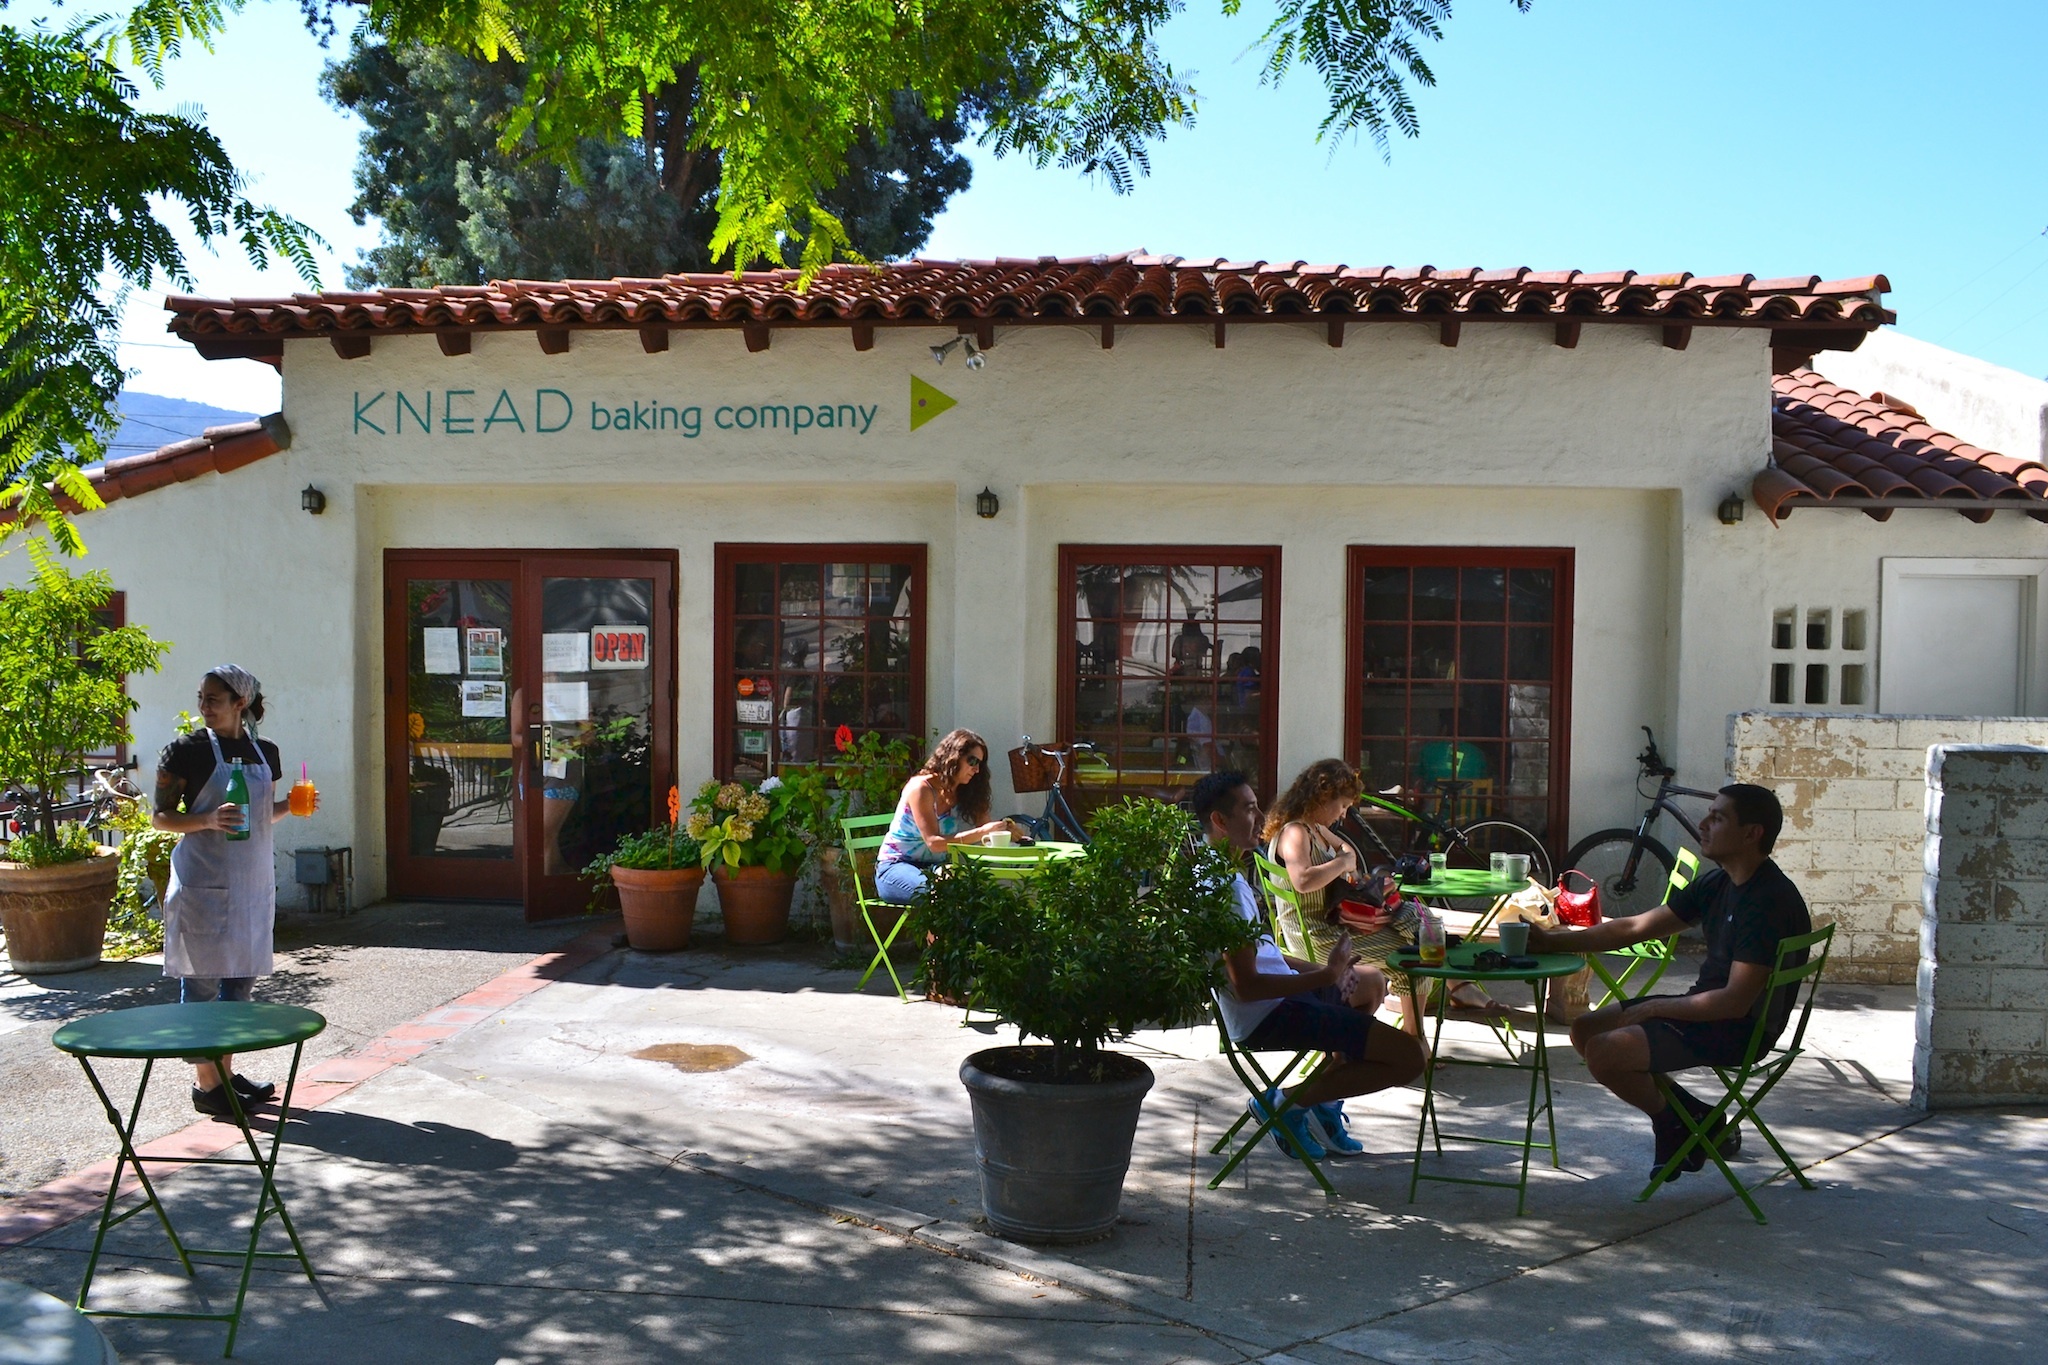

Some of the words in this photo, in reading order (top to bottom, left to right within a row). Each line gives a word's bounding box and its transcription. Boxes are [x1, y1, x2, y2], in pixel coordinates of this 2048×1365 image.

[354, 389, 573, 435] KNEAD
[591, 400, 702, 438] baking
[714, 404, 878, 435] company
[595, 632, 645, 662] OPEN
